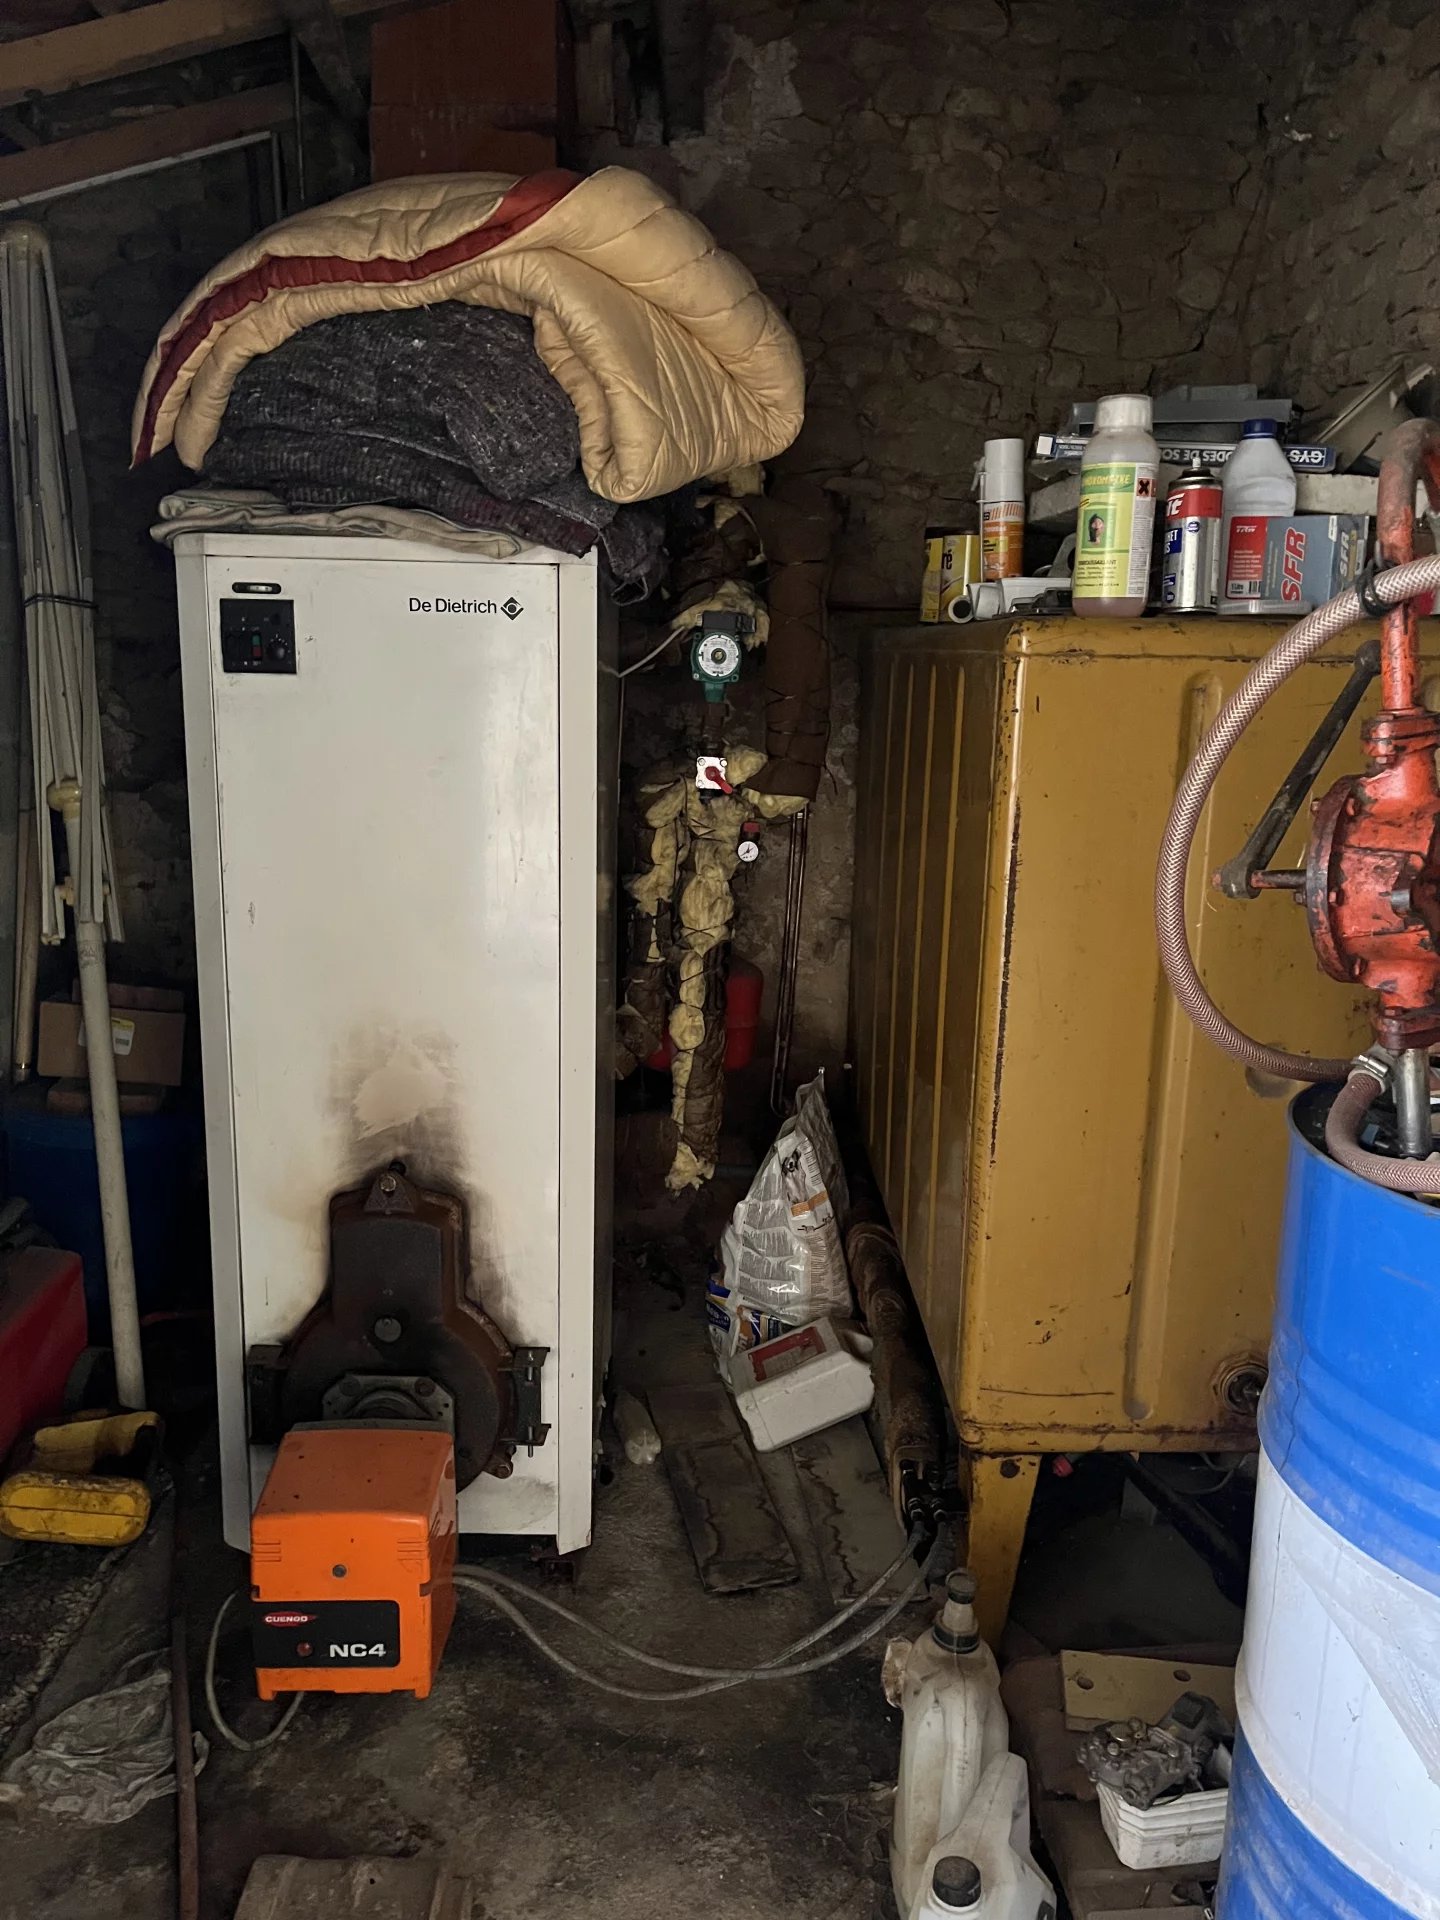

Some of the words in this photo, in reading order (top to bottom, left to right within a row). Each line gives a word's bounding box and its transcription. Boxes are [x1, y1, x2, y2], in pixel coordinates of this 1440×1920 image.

[1290, 449, 1325, 464] GYS
[1236, 525, 1258, 533] TRW
[1340, 531, 1350, 577] SFR
[1281, 526, 1307, 601] SFR
[409, 597, 432, 613] De
[435, 598, 497, 614] Dietrich
[265, 1615, 308, 1623] CUENOD
[329, 1643, 387, 1658] NC4
